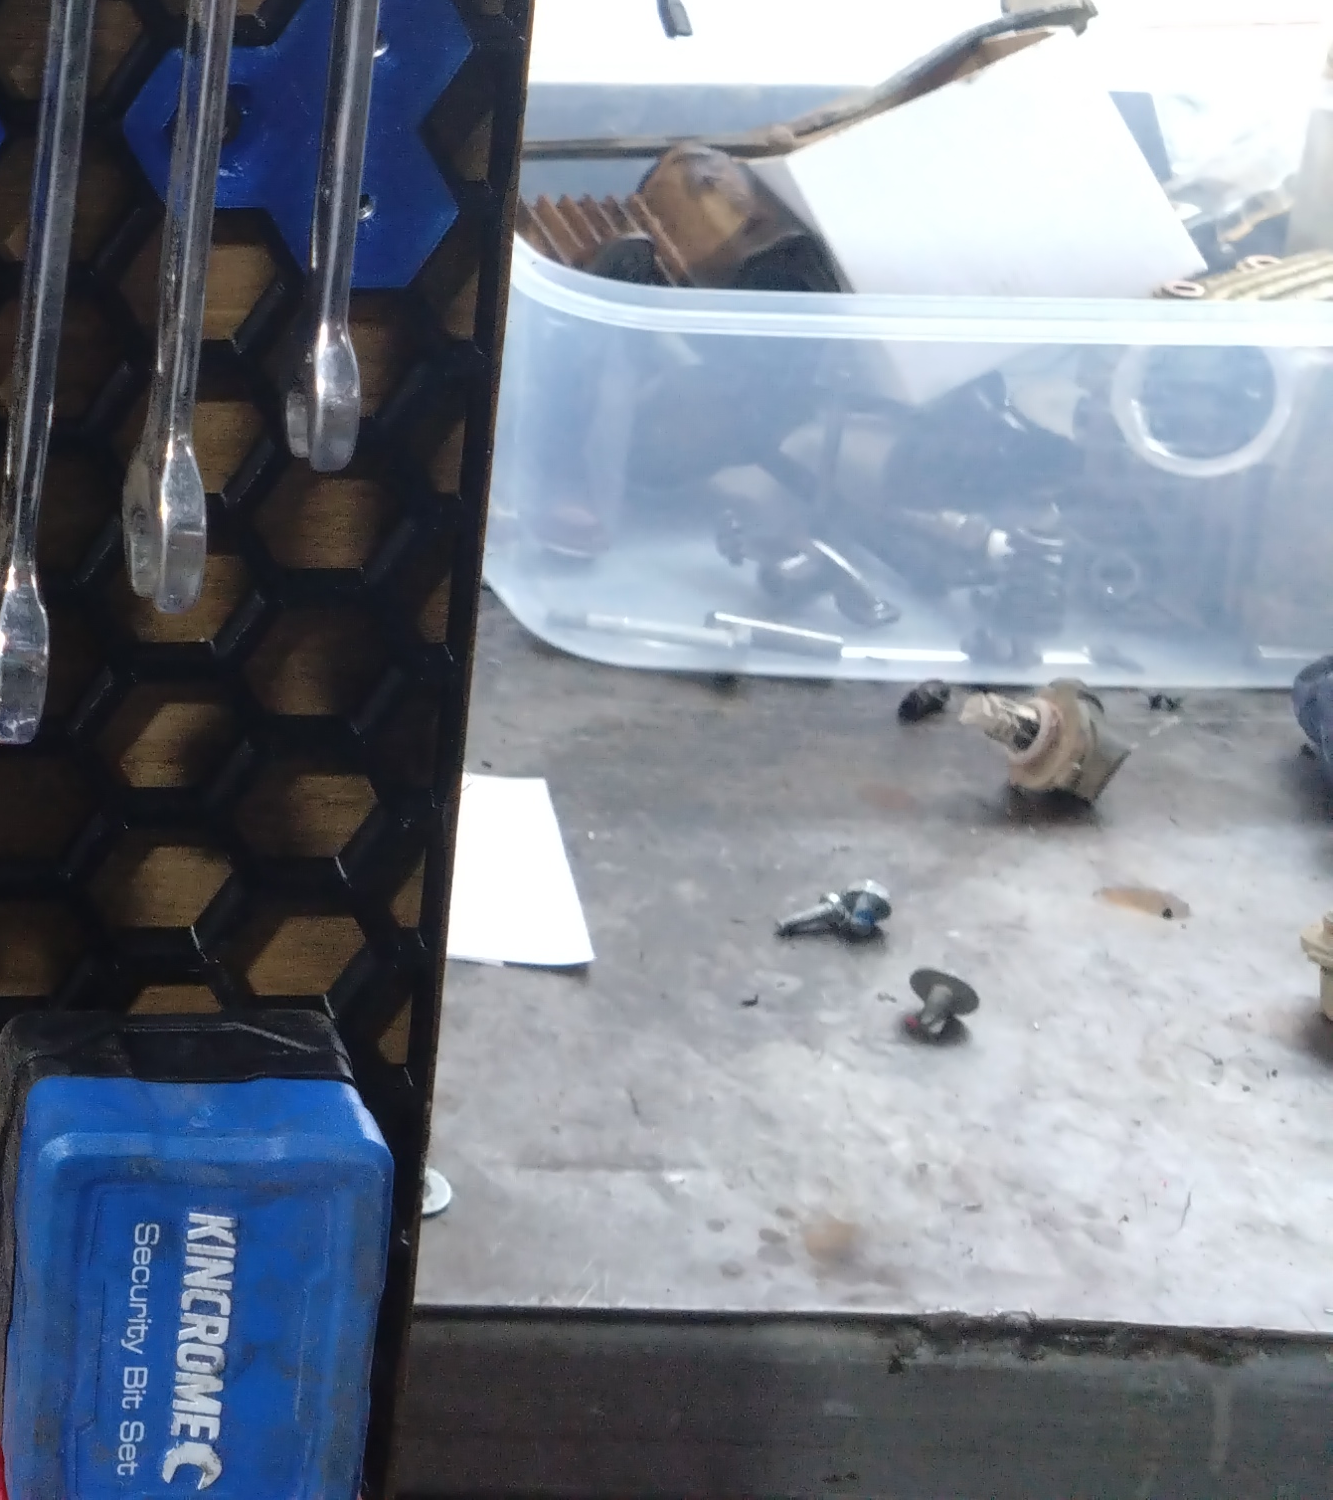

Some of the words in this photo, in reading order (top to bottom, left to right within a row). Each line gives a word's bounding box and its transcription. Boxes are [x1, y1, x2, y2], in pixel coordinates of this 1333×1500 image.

[120, 1222, 160, 1356] Security
[170, 1210, 239, 1447] KINCROME
[120, 1365, 148, 1409] Bit
[117, 1419, 146, 1477] Set
